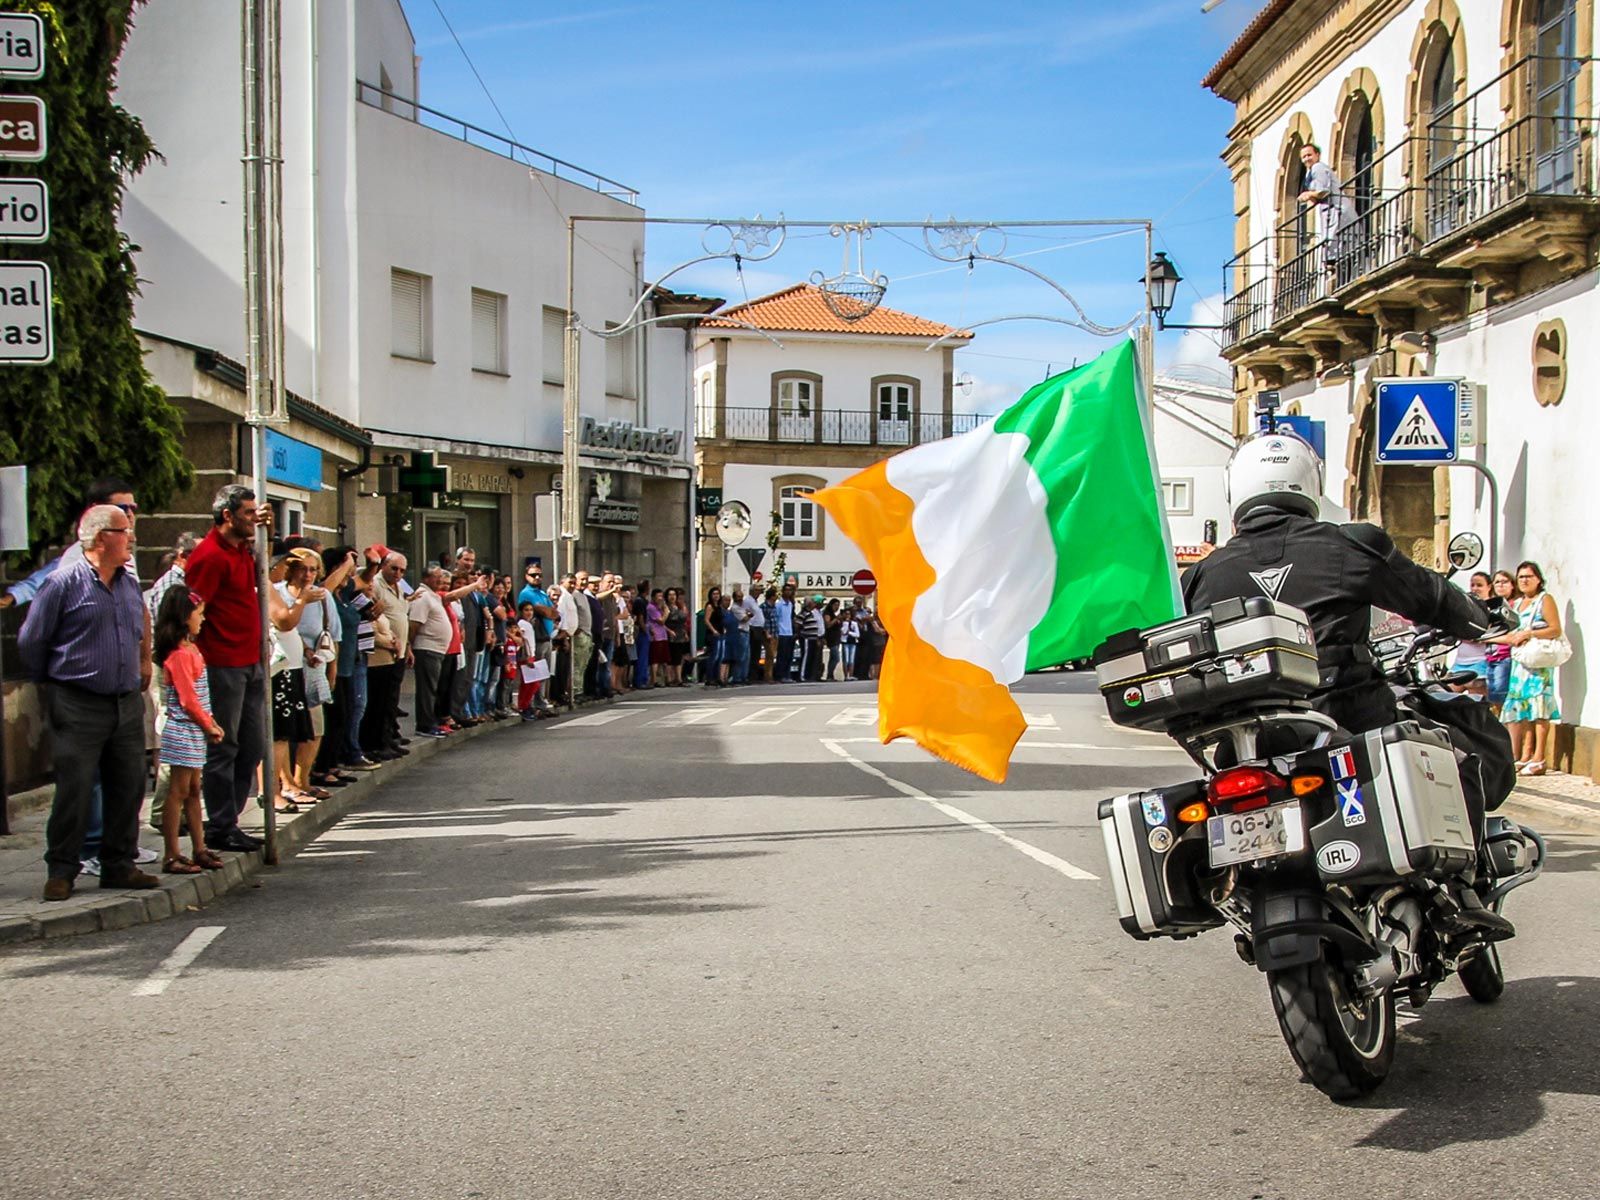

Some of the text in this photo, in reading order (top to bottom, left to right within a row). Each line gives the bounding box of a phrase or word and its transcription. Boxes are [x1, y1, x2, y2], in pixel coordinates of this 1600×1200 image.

[0, 119, 36, 141] ca
[0, 325, 42, 345] as
[807, 575, 833, 587] BAR
[1345, 814, 1364, 825] SCO
[1326, 850, 1351, 866] IRL
